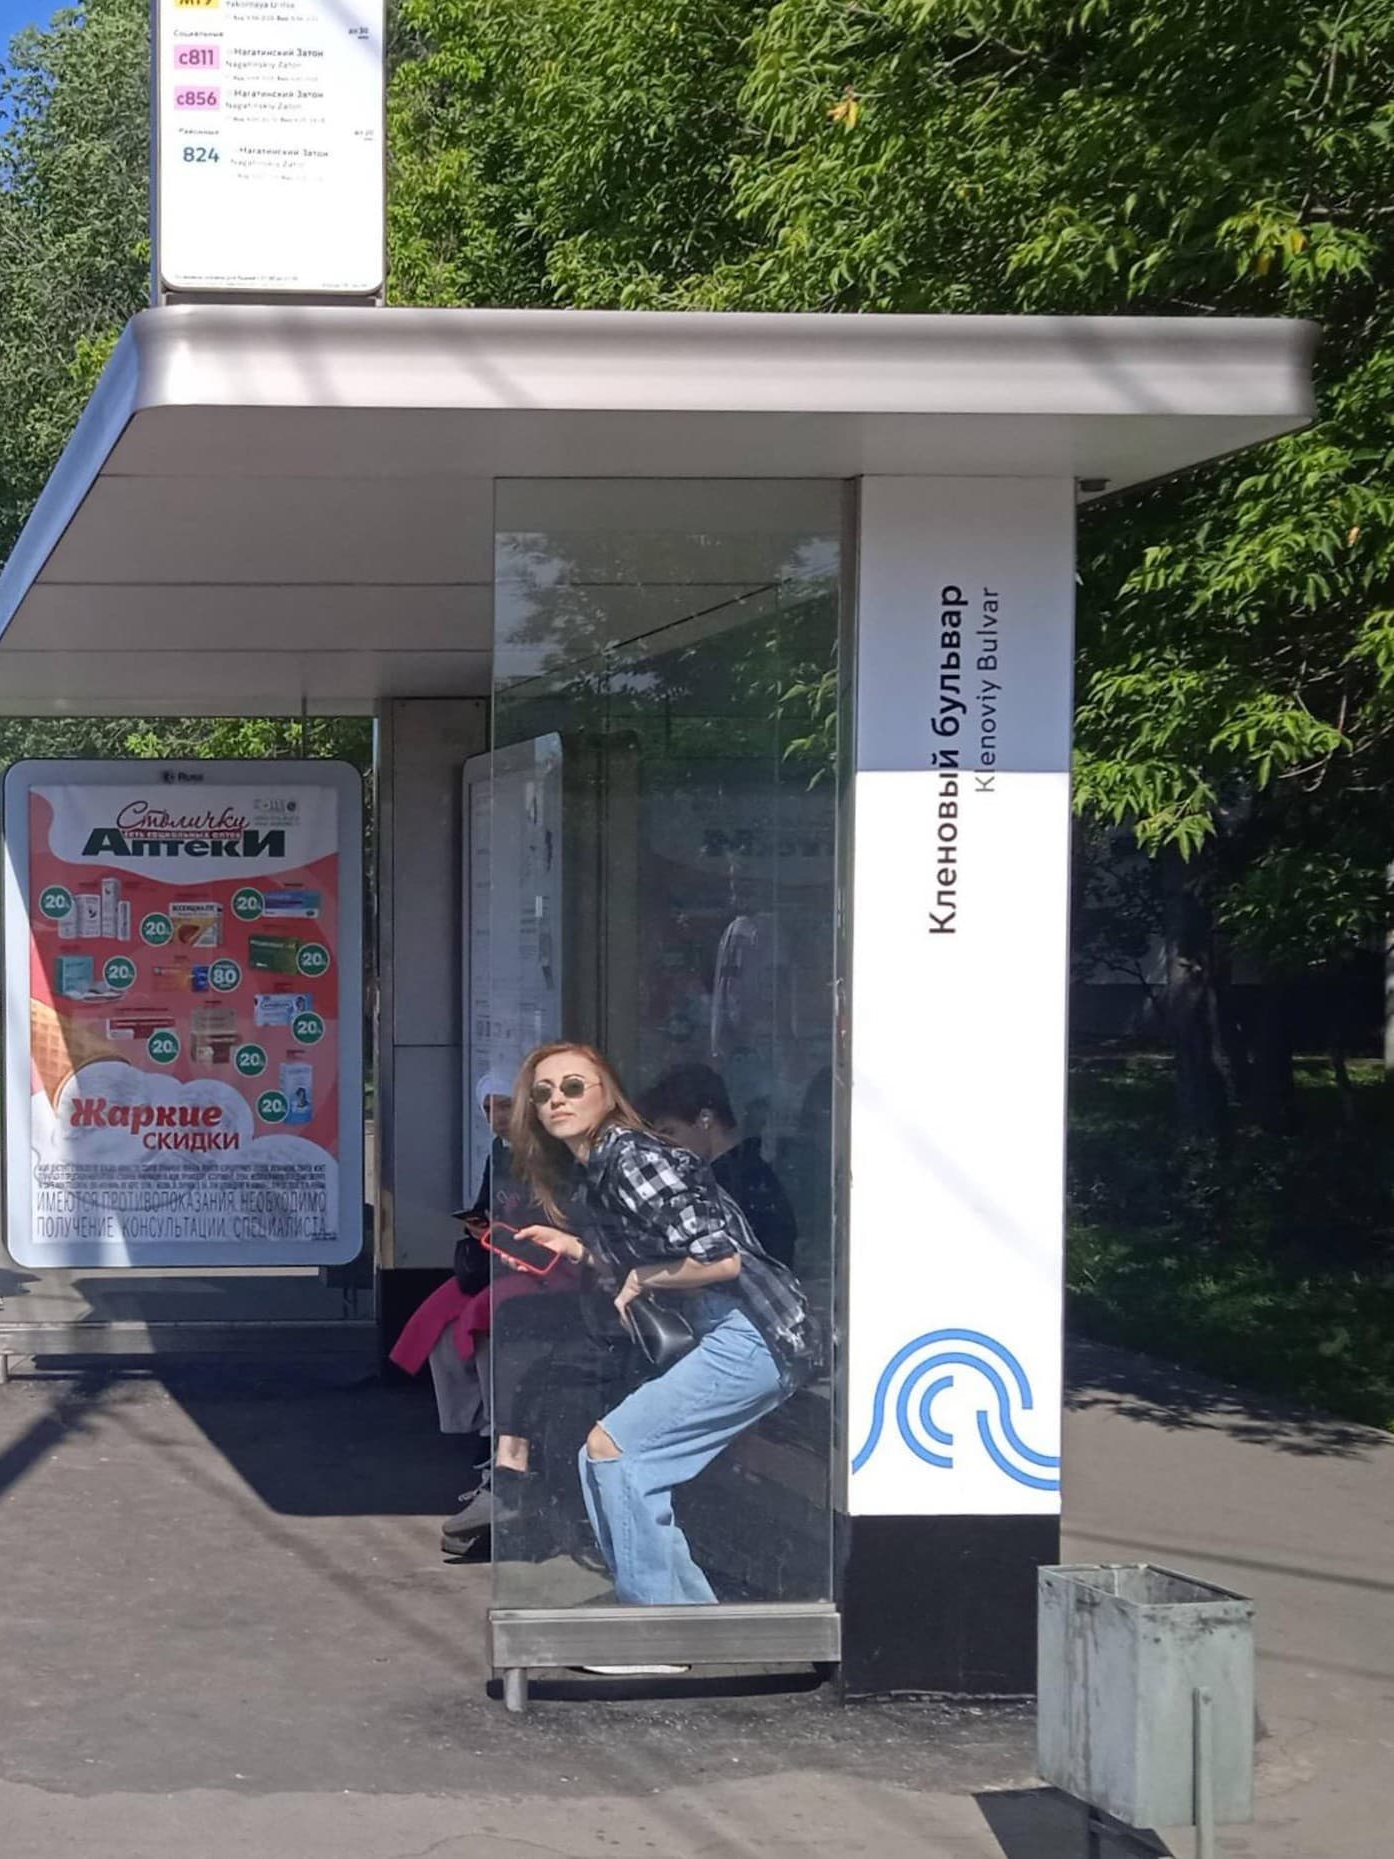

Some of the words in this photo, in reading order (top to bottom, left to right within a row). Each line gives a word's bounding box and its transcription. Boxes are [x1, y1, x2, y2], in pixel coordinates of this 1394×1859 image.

[296, 48, 324, 58] Затон
[183, 147, 220, 163] 824
[975, 587, 1000, 671] Bulvar
[931, 585, 968, 737] бульвар
[975, 680, 1002, 793] Klenoviy
[116, 800, 250, 829] Столички
[928, 749, 960, 934] Кленовый
[213, 969, 237, 984] 80
[70, 1098, 222, 1134] Жаркие
[37, 1190, 97, 1213] ИМЕЮТСЯ
[37, 1216, 114, 1238] ПОЛУЧЕНИЕ
[122, 1216, 226, 1240] КОНСУЛЬТАЦИИ
